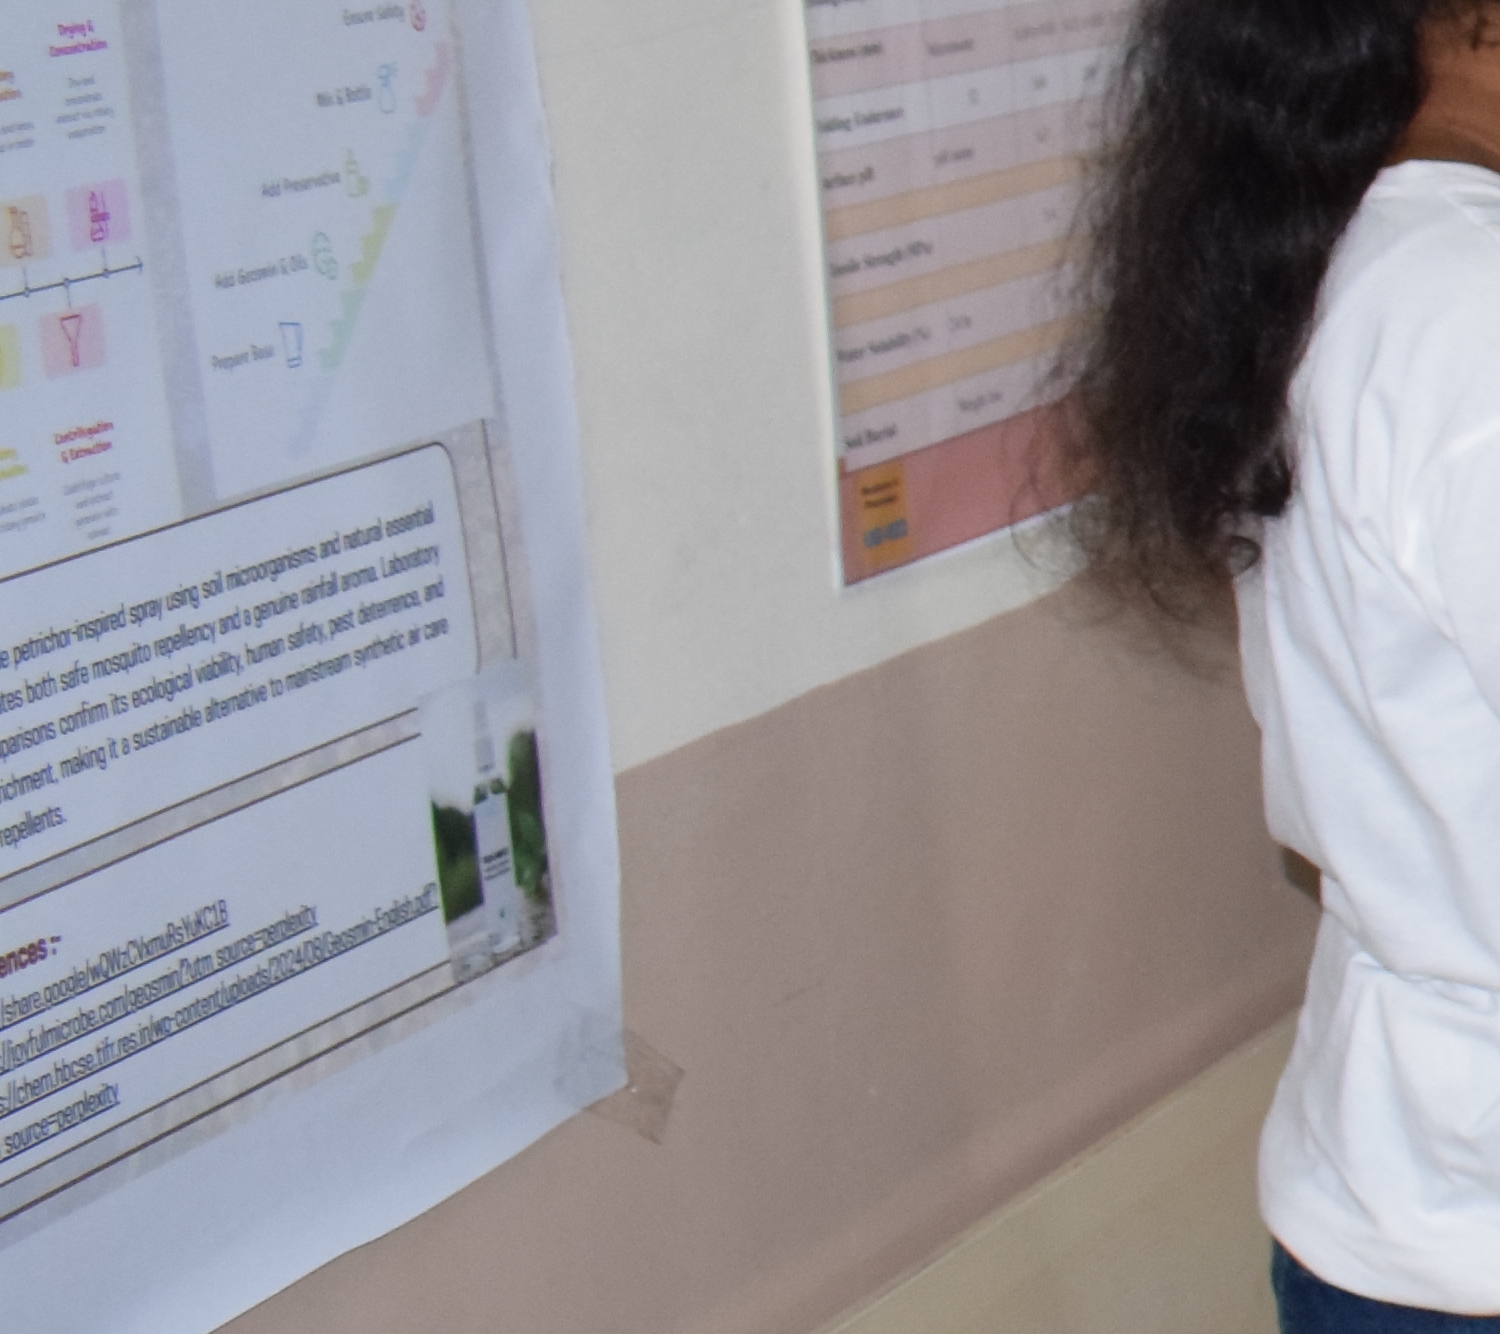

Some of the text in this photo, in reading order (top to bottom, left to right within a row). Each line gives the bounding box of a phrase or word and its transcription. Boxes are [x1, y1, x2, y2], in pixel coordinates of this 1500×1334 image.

[14, 602, 126, 669] petrichor-inspired
[130, 596, 163, 626] spray
[166, 584, 200, 610] using
[203, 570, 224, 599] soil
[226, 545, 317, 591] microorganisms
[319, 530, 341, 559] and
[342, 517, 383, 551] natural
[385, 500, 434, 538] essential
[25, 673, 57, 705] both
[60, 660, 89, 692] safe
[92, 641, 151, 680] mosquito
[154, 620, 216, 660] repellency
[218, 605, 241, 635] and
[253, 591, 299, 629] genuine
[300, 570, 338, 605] rainfall
[340, 565, 378, 593] aroma.
[381, 543, 439, 579] Laboratory
[59, 700, 108, 735] confirm
[110, 692, 129, 717] its
[132, 665, 193, 710] ecological
[195, 650, 244, 684] viability,
[246, 637, 285, 667] human
[287, 620, 327, 652] safety,
[328, 608, 354, 641] pest
[355, 589, 421, 626] deterrence,
[424, 573, 444, 603] and
[60, 744, 107, 779] making
[109, 735, 118, 759] it
[121, 736, 130, 755] a
[133, 704, 202, 752] sustainable
[205, 683, 267, 724] alternative
[269, 677, 283, 699] to
[285, 653, 351, 692] mainstream
[353, 629, 404, 668] synthetic
[423, 617, 448, 641] care
